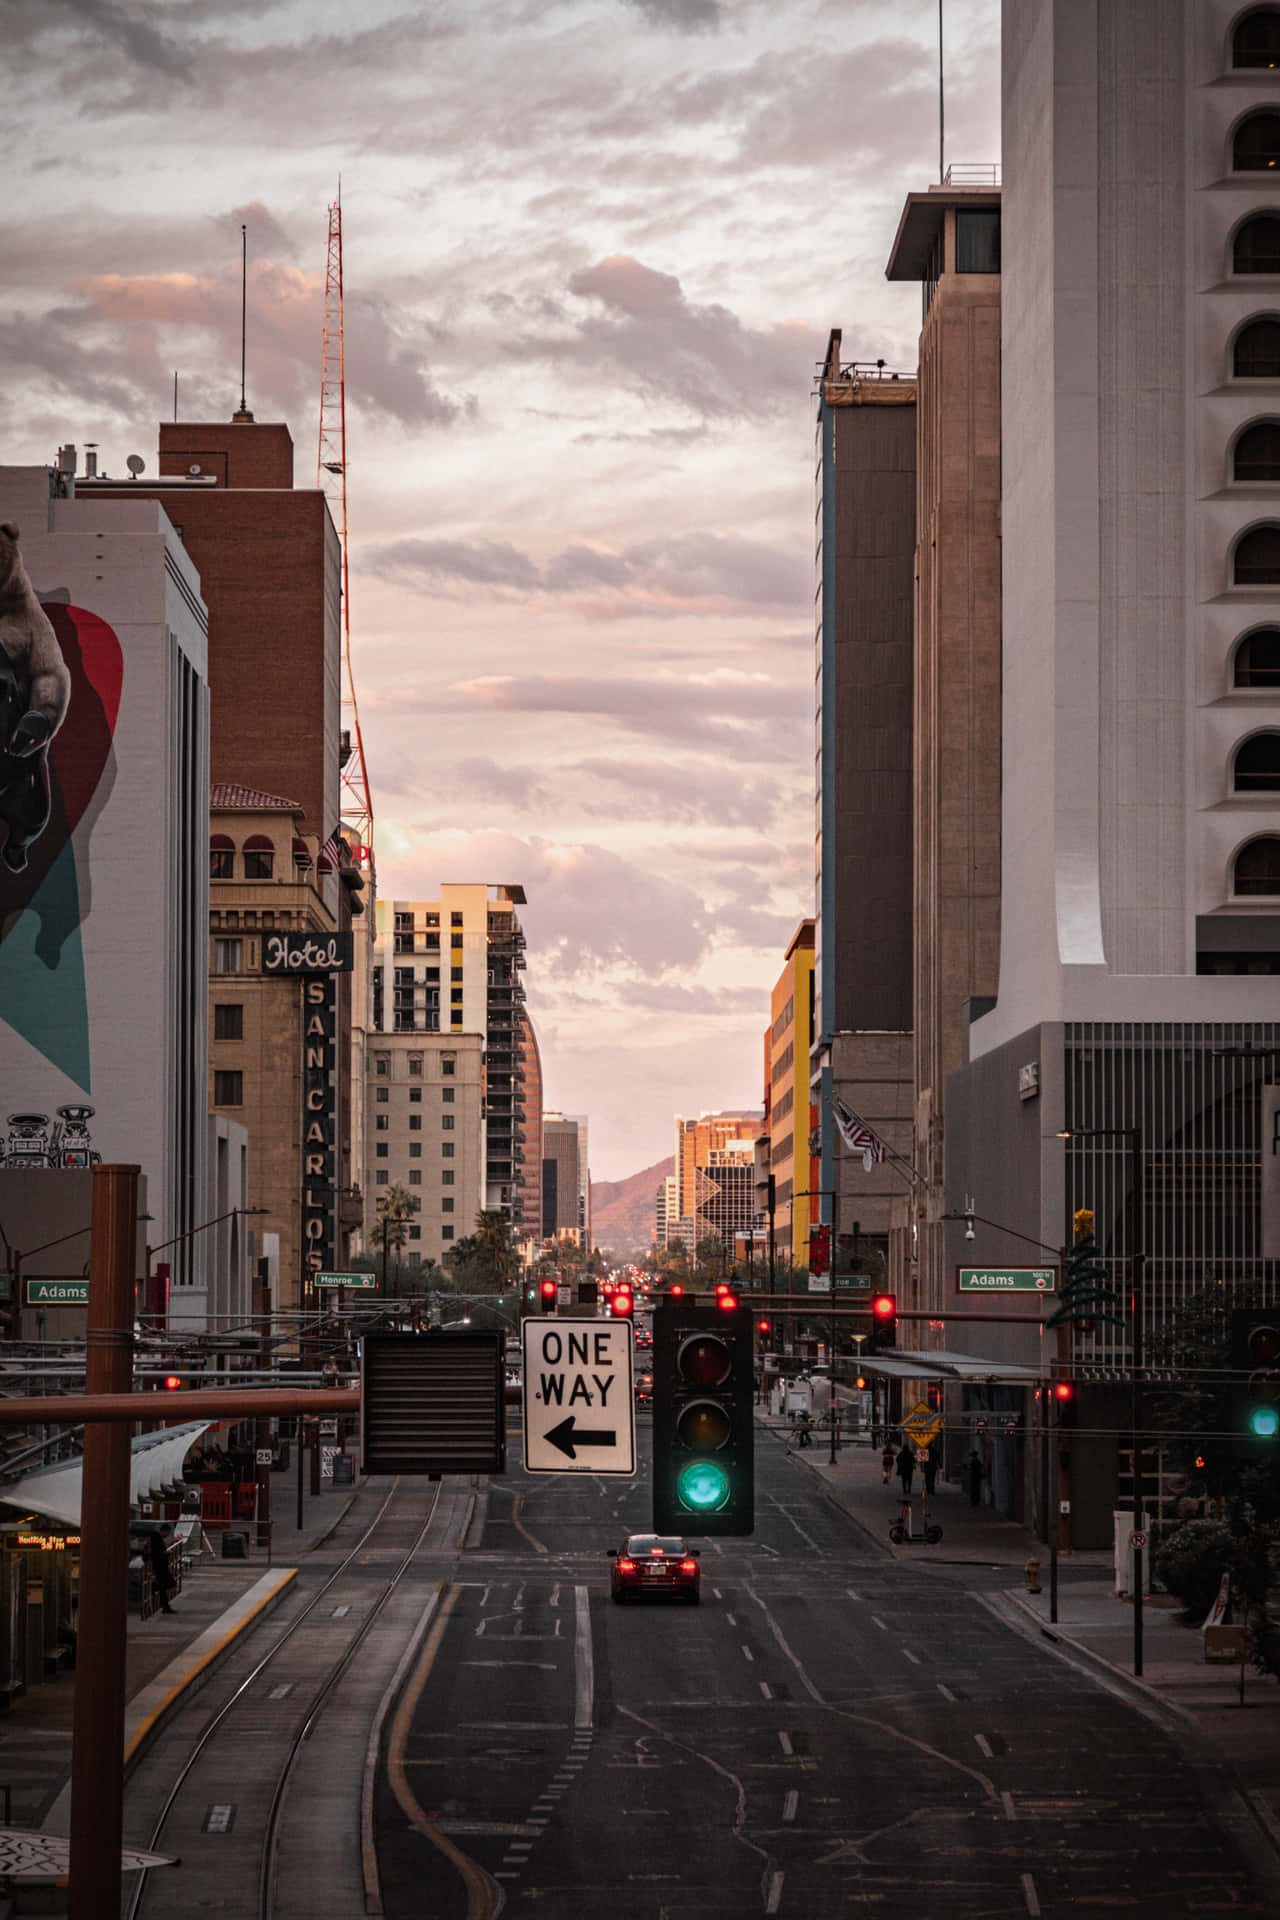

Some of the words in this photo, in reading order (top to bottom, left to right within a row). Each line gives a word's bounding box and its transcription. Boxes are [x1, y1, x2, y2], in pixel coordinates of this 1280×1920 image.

[265, 936, 344, 969] Hotel
[307, 981, 325, 1070] SAN
[306, 1088, 324, 1272] CARLOS
[39, 1286, 87, 1298] Adams
[321, 1276, 352, 1284] Monroe
[969, 1275, 1015, 1286] Adams
[542, 1332, 612, 1366] ONE
[540, 1374, 615, 1407] WAY
[258, 1452, 271, 1462] 25
